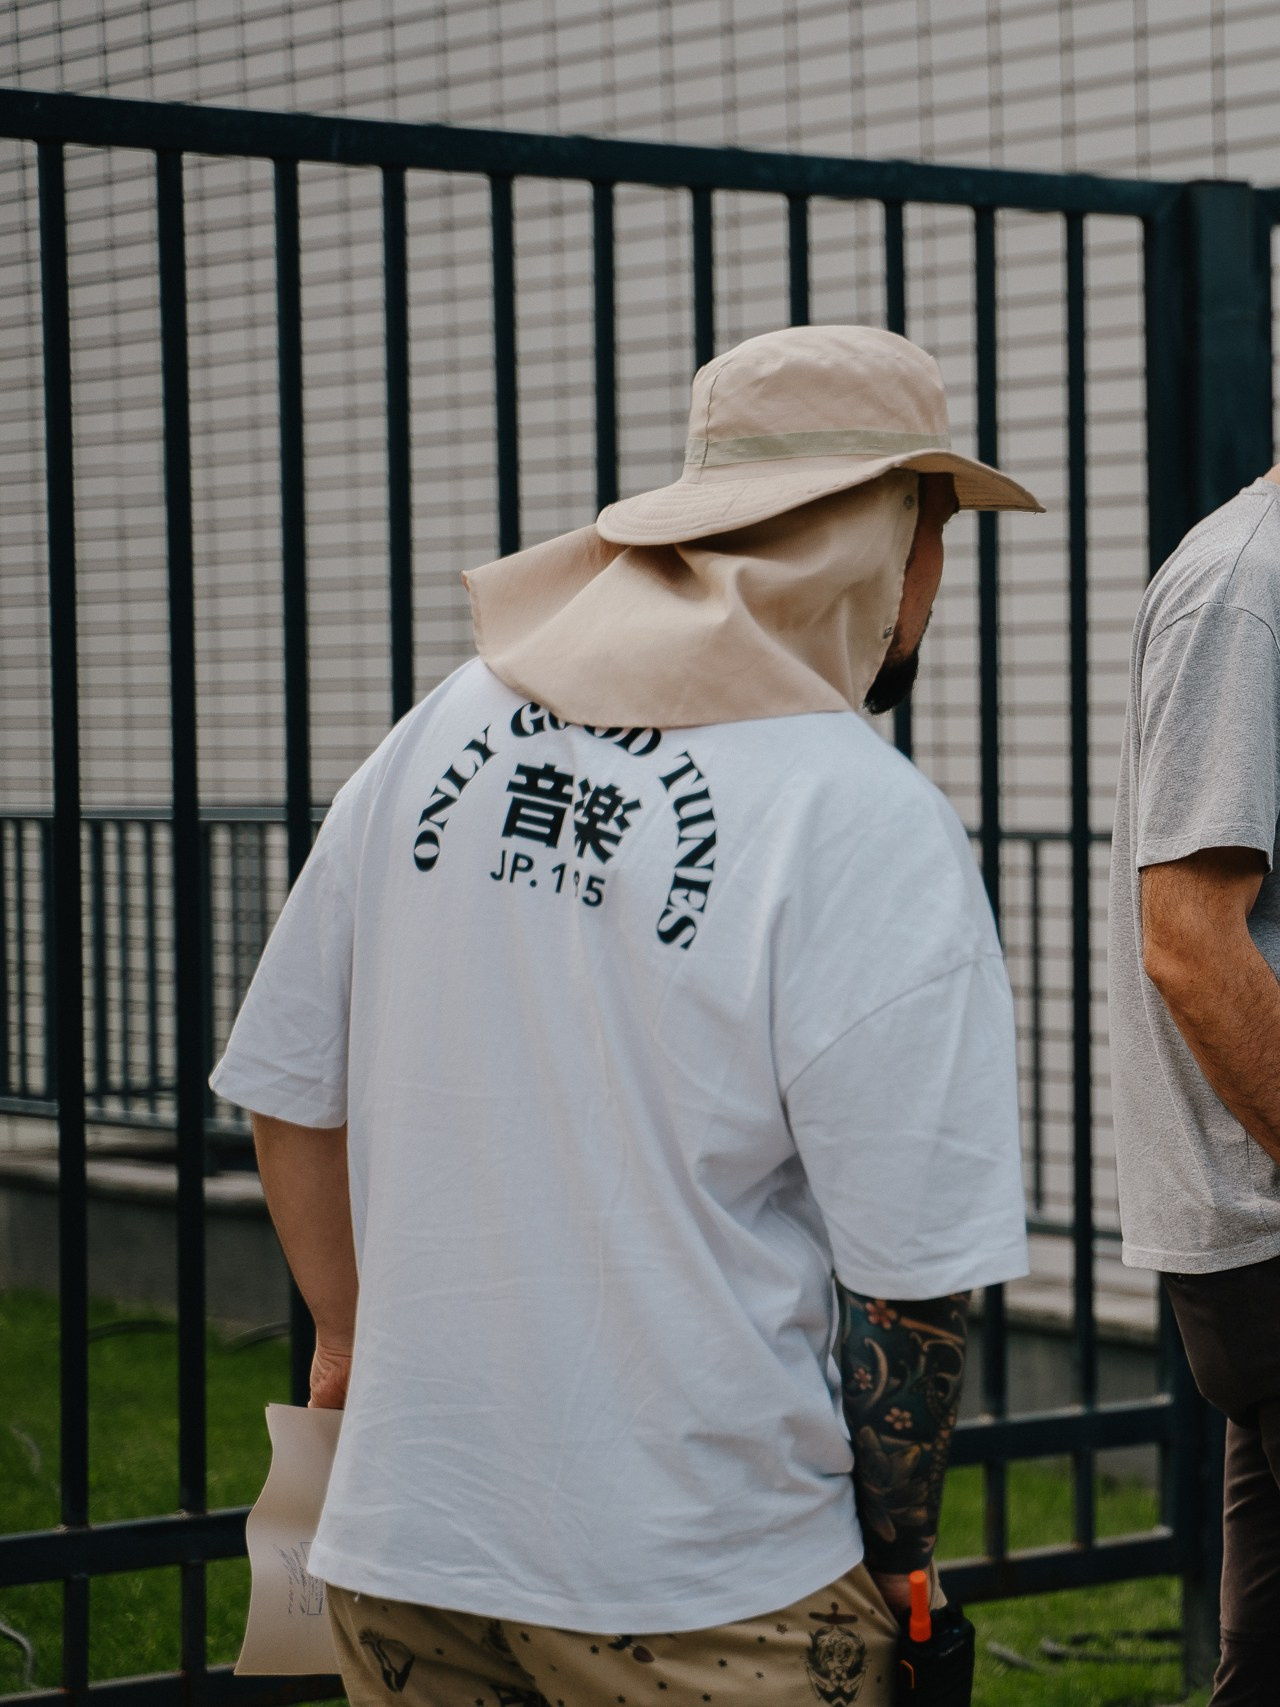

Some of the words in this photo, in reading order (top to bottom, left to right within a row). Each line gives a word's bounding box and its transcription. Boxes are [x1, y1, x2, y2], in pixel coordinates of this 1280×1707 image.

[413, 723, 499, 873] ONLY
[657, 750, 717, 951] TUNES
[501, 763, 642, 865] 音楽
